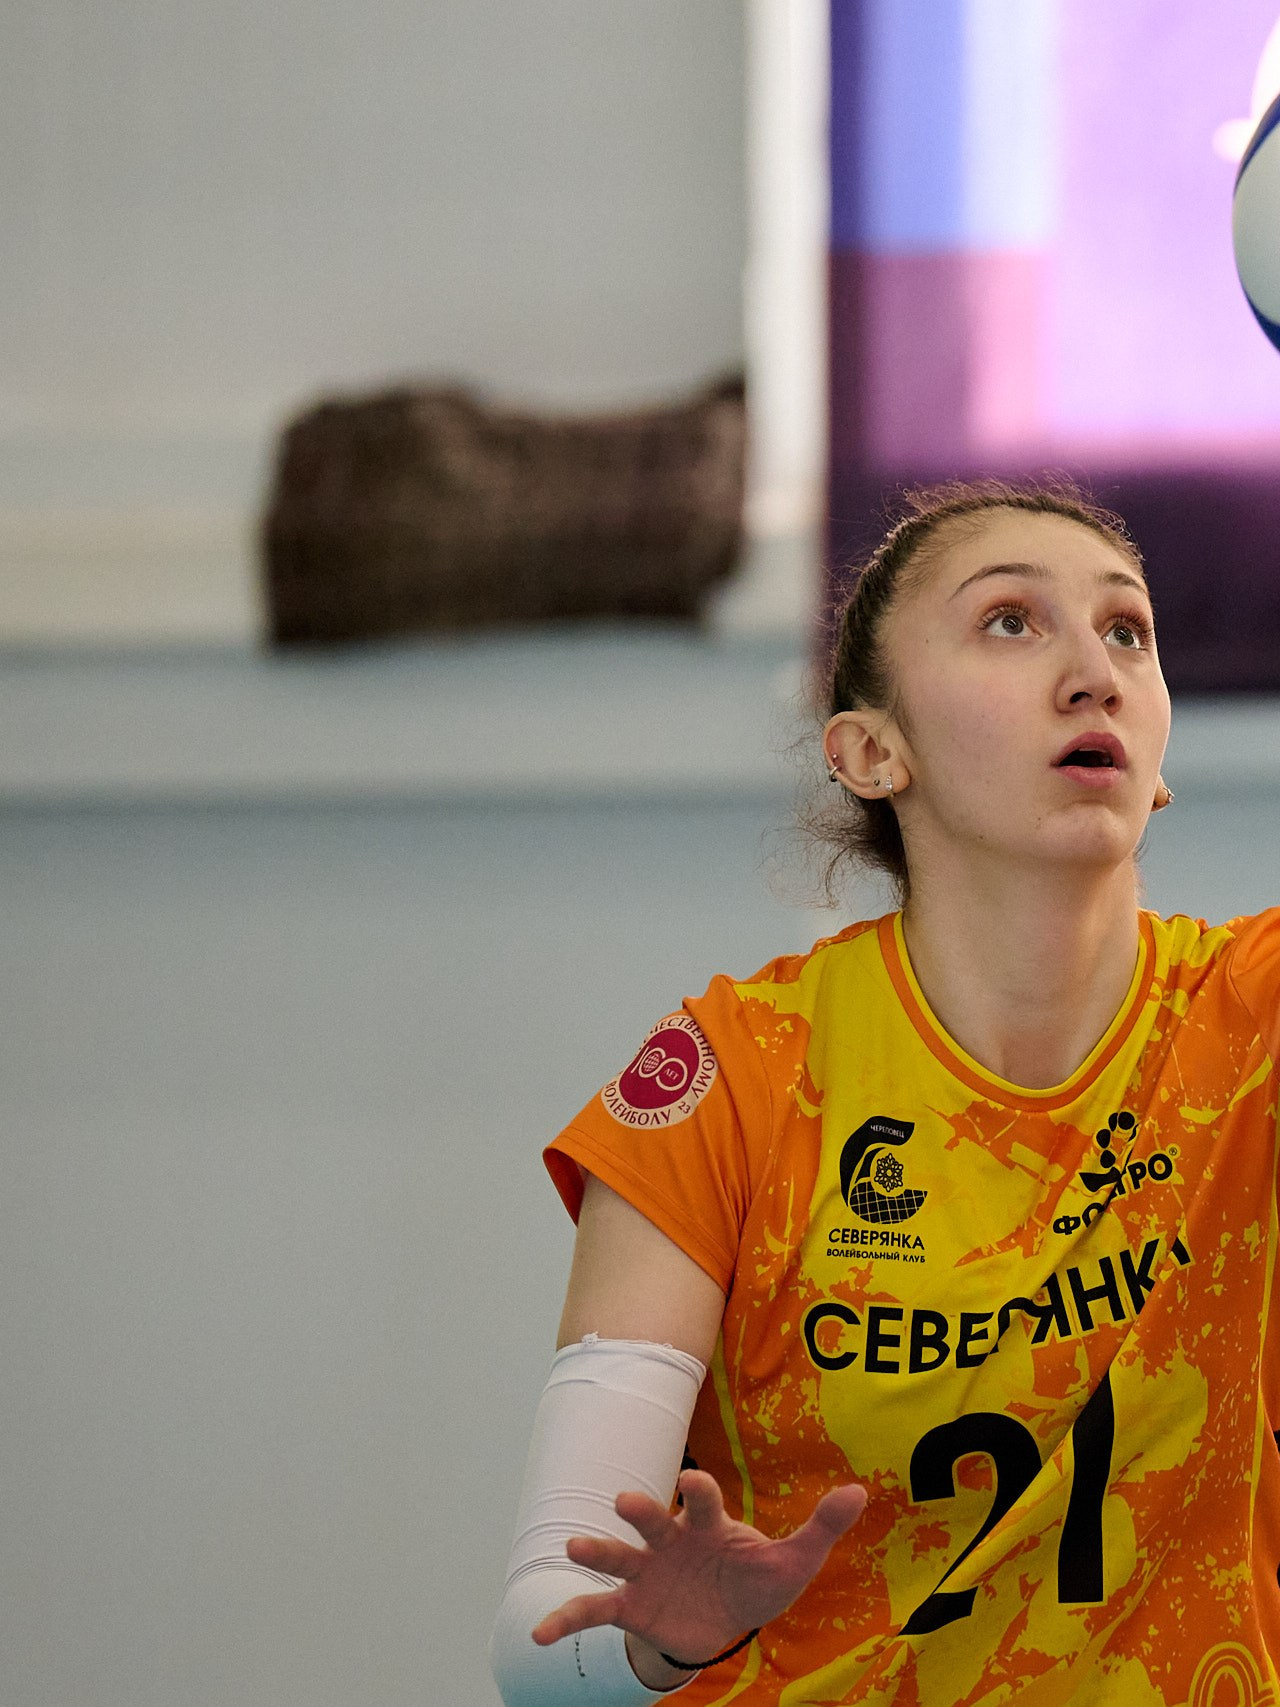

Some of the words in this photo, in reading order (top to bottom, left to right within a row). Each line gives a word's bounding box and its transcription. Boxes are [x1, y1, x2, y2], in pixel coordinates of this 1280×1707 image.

[603, 1080, 672, 1126] ВОЛЕЙБОЛУ
[677, 1101, 692, 1114] 23
[870, 1124, 905, 1139] ЧЕРЕПОВЕЦ
[828, 1228, 926, 1251] СЕВЕРЯНКА
[826, 1248, 901, 1261] ВОЛЕЙБОЛЬНЫЙ
[902, 1254, 926, 1264] КЛУБ
[898, 1368, 1116, 1637] 21
